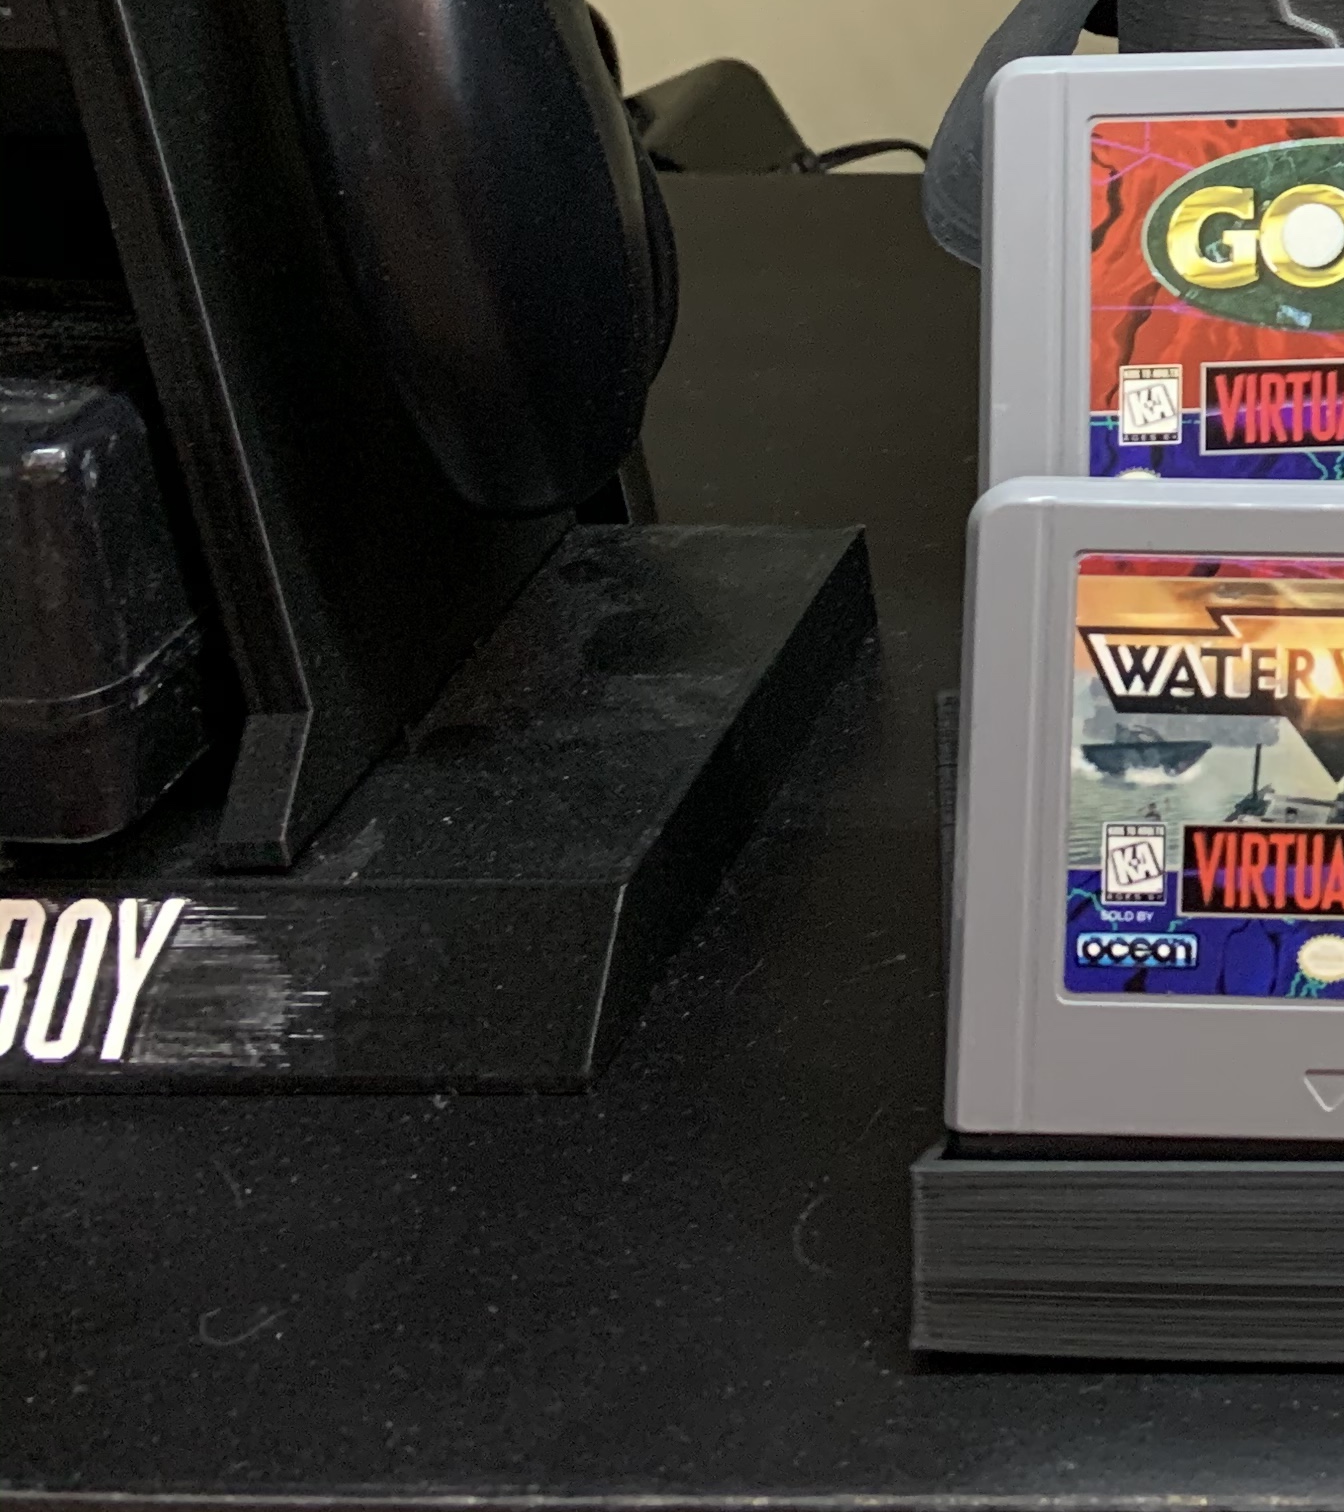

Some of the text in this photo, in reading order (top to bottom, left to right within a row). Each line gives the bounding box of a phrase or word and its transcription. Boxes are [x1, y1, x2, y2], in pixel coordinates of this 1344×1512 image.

[1101, 909, 1154, 922] SOLD BY
[1082, 937, 1193, 965] ocean
